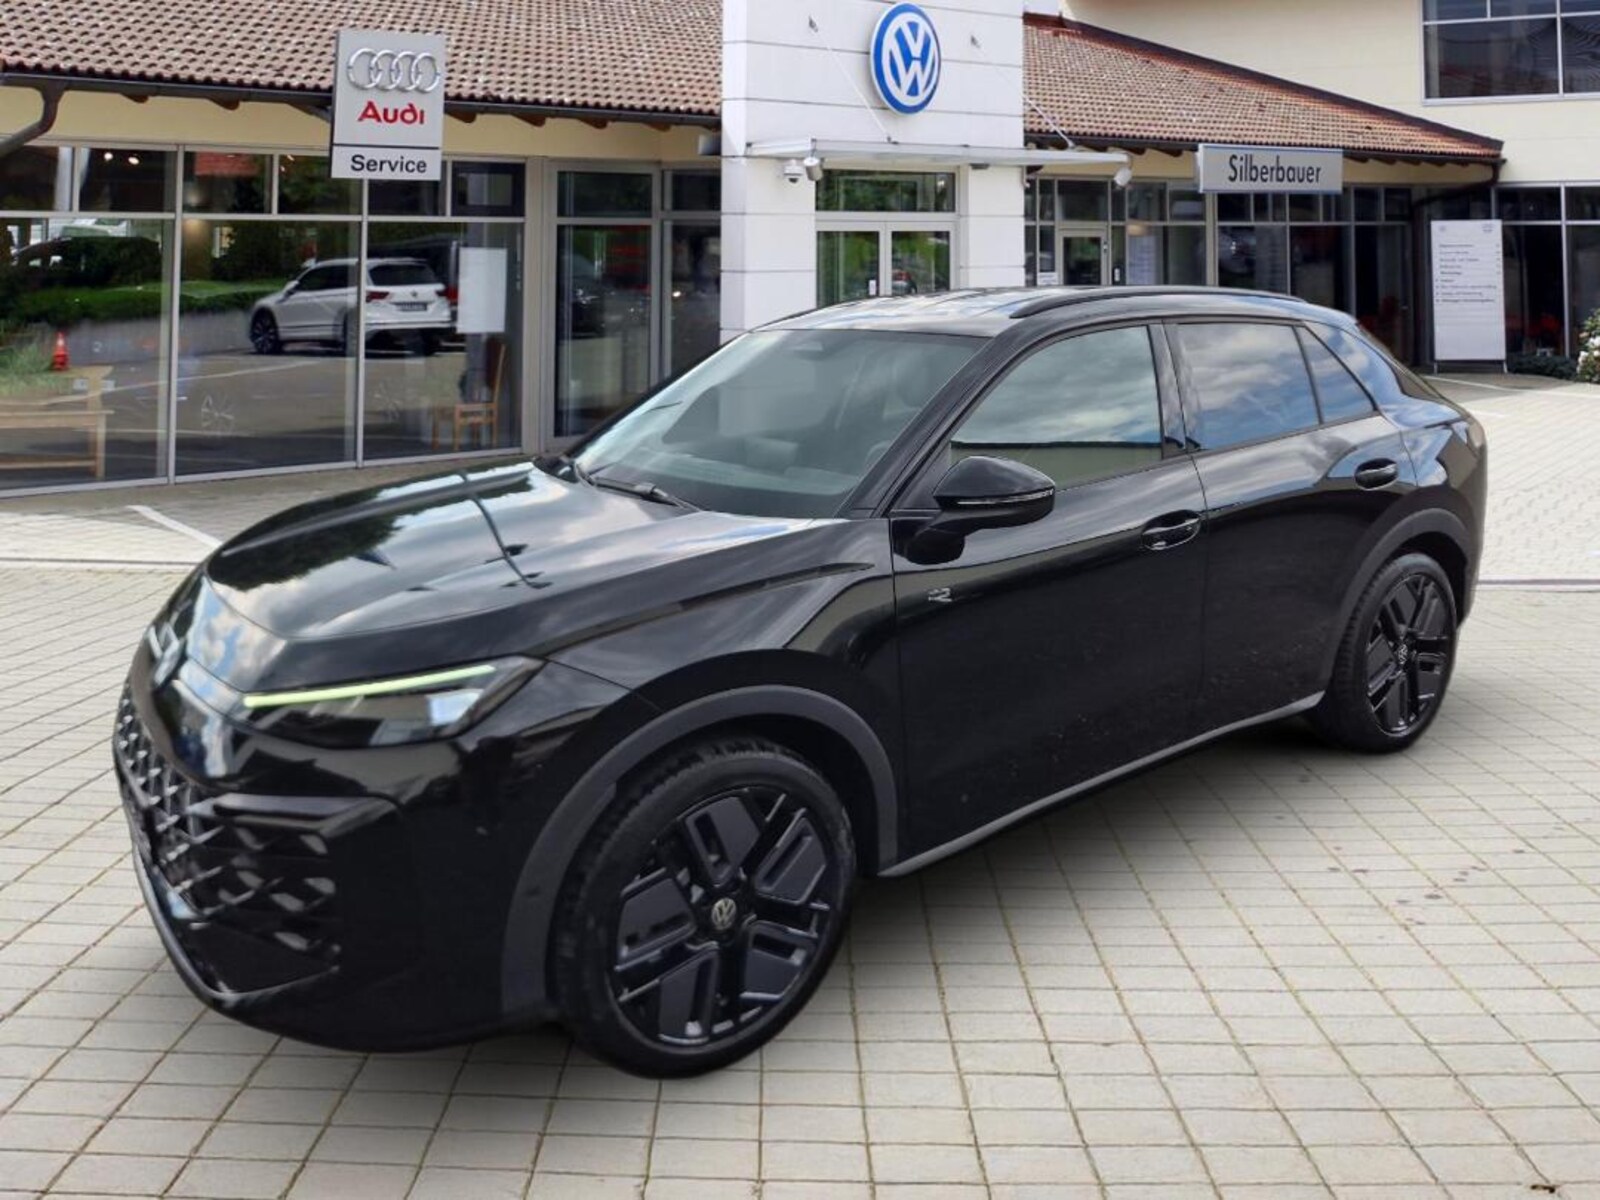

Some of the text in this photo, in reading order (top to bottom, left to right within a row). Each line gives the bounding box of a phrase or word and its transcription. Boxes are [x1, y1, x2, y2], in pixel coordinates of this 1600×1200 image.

[877, 10, 939, 107] VW
[357, 100, 425, 125] Audi
[350, 153, 427, 174] Service
[1227, 153, 1322, 184] Silberbauer
